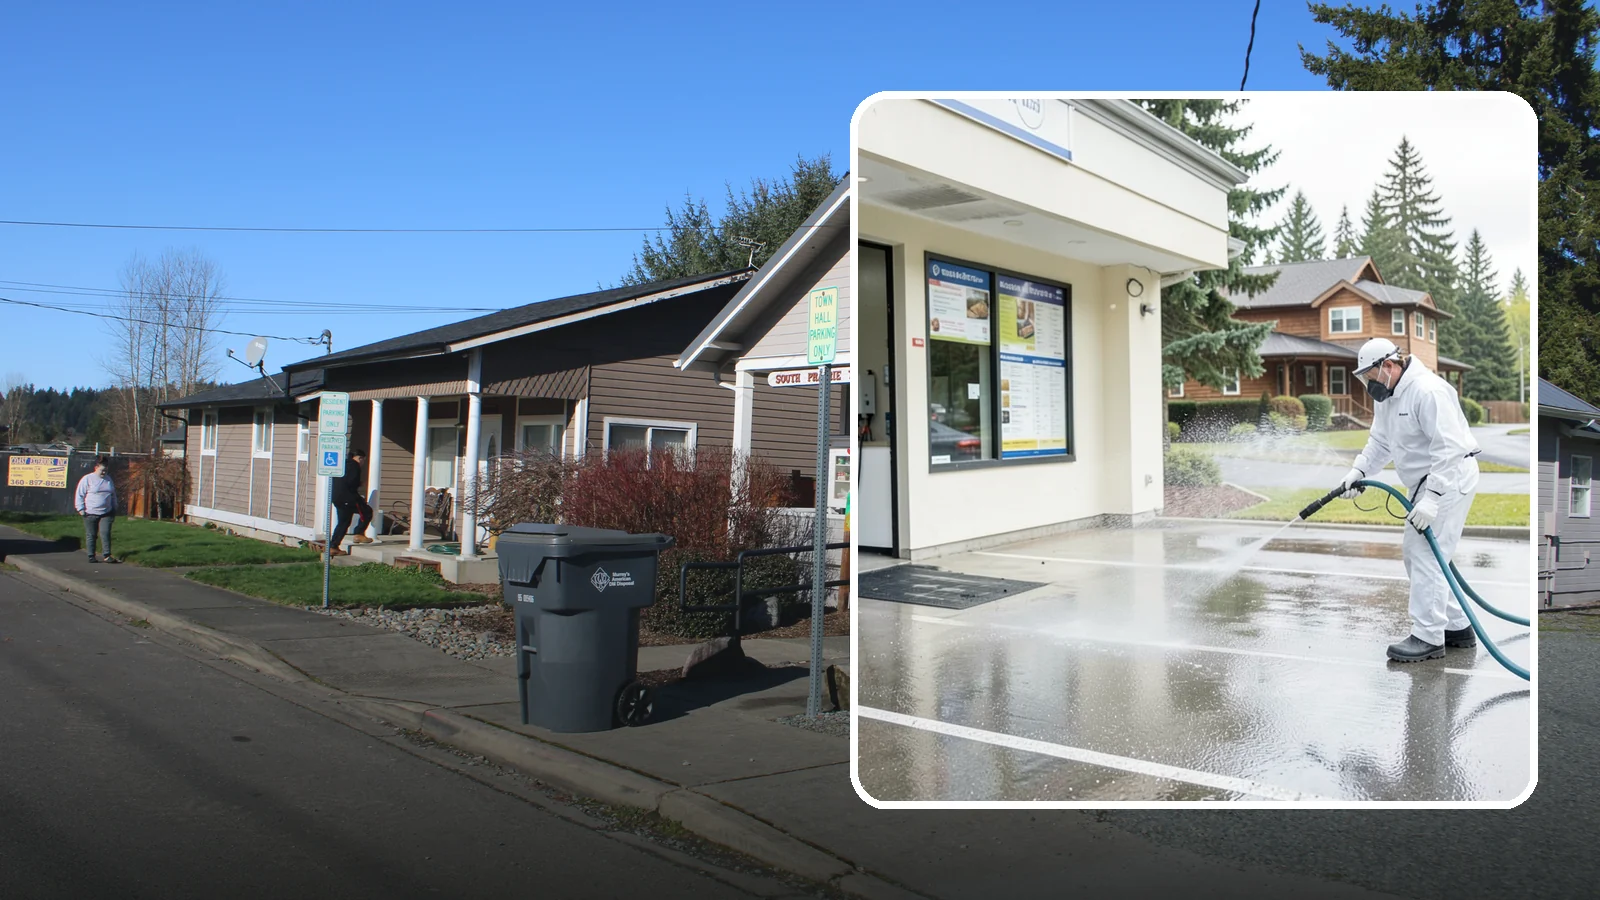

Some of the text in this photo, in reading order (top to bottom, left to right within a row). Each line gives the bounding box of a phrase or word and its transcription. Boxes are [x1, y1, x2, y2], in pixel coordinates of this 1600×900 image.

[815, 295, 832, 308] TOWN
[815, 312, 831, 324] HALL
[810, 327, 836, 340] PARKING
[814, 344, 831, 357] ONLY
[776, 374, 800, 384] SOUTH
